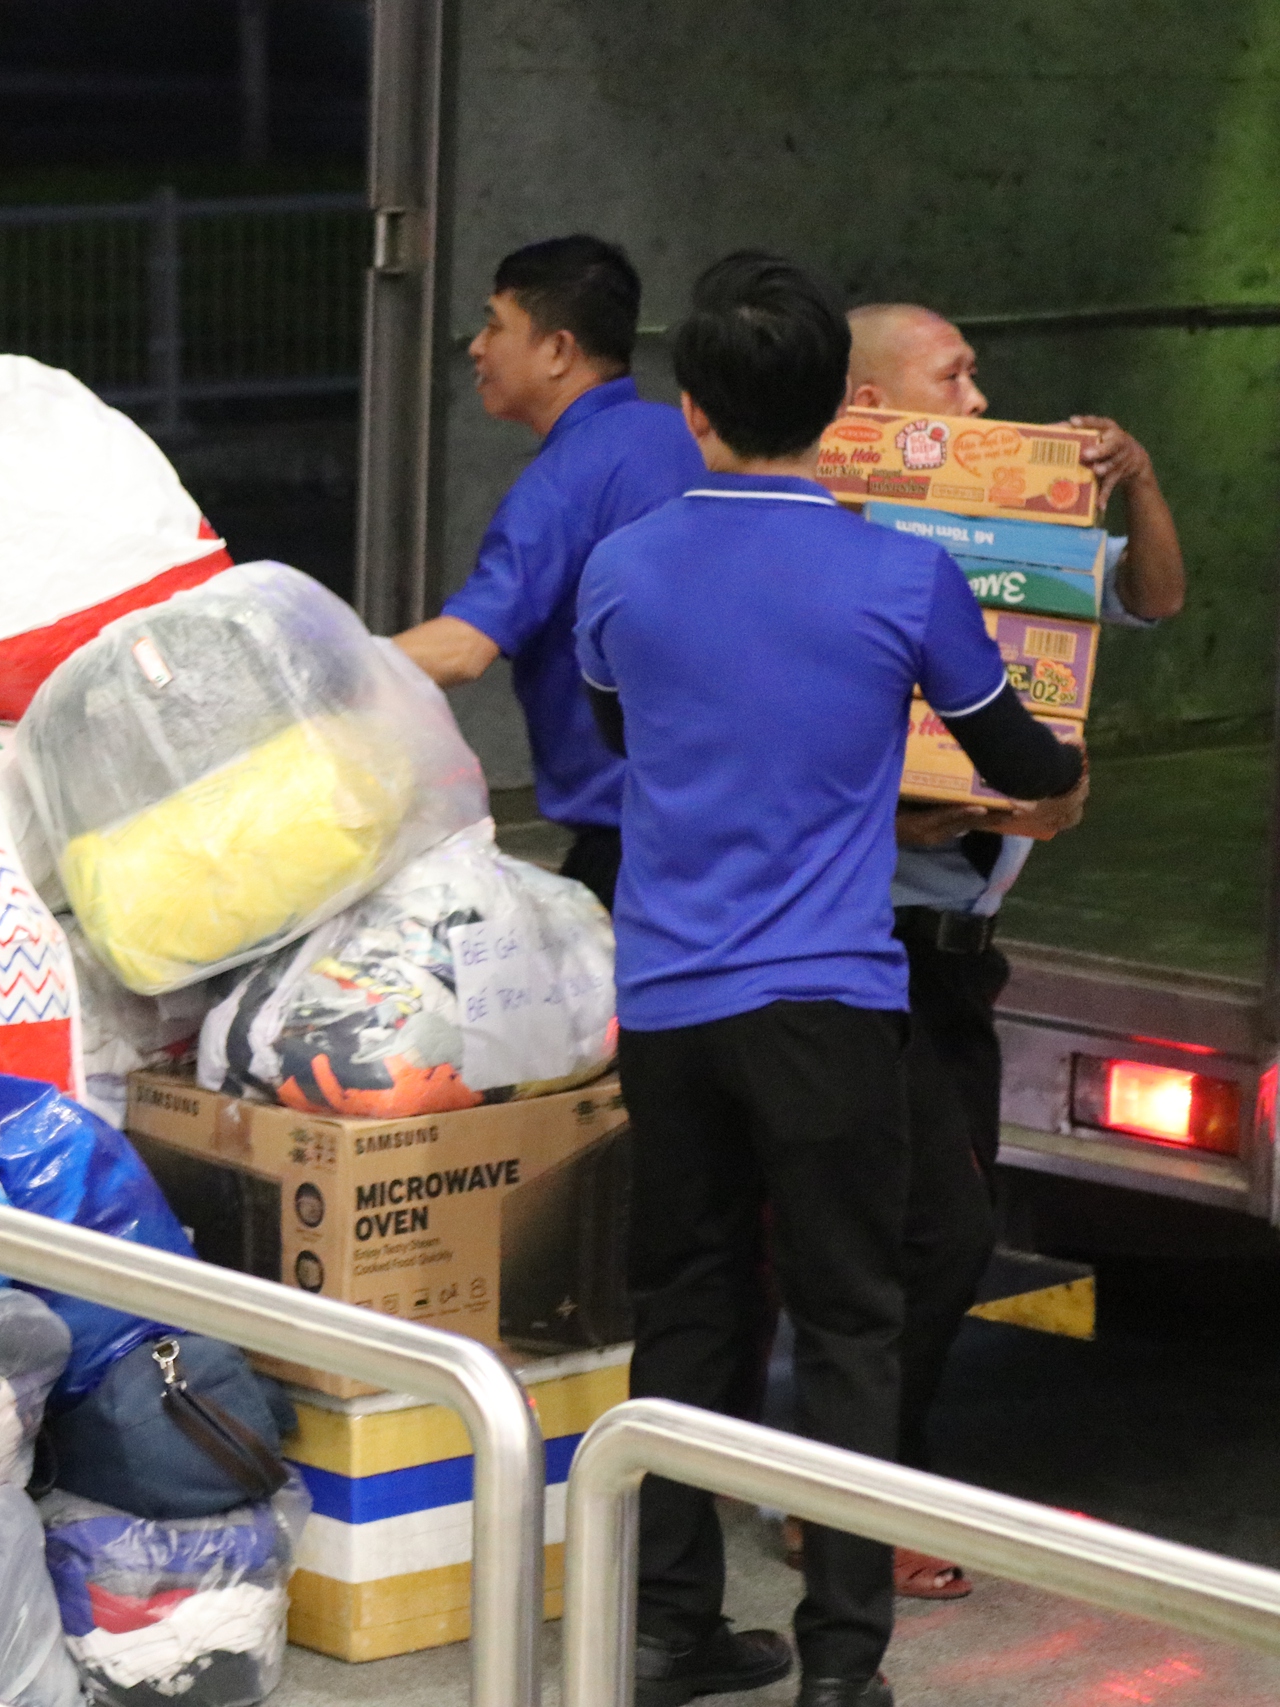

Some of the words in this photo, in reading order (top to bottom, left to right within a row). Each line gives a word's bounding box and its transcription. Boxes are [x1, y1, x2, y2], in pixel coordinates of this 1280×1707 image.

[974, 530, 995, 545] Mì
[1032, 679, 1060, 703] 02
[356, 1125, 439, 1154] SAMSUNG
[356, 1158, 520, 1211] MICROWAVE
[355, 1206, 429, 1241] OVEN
